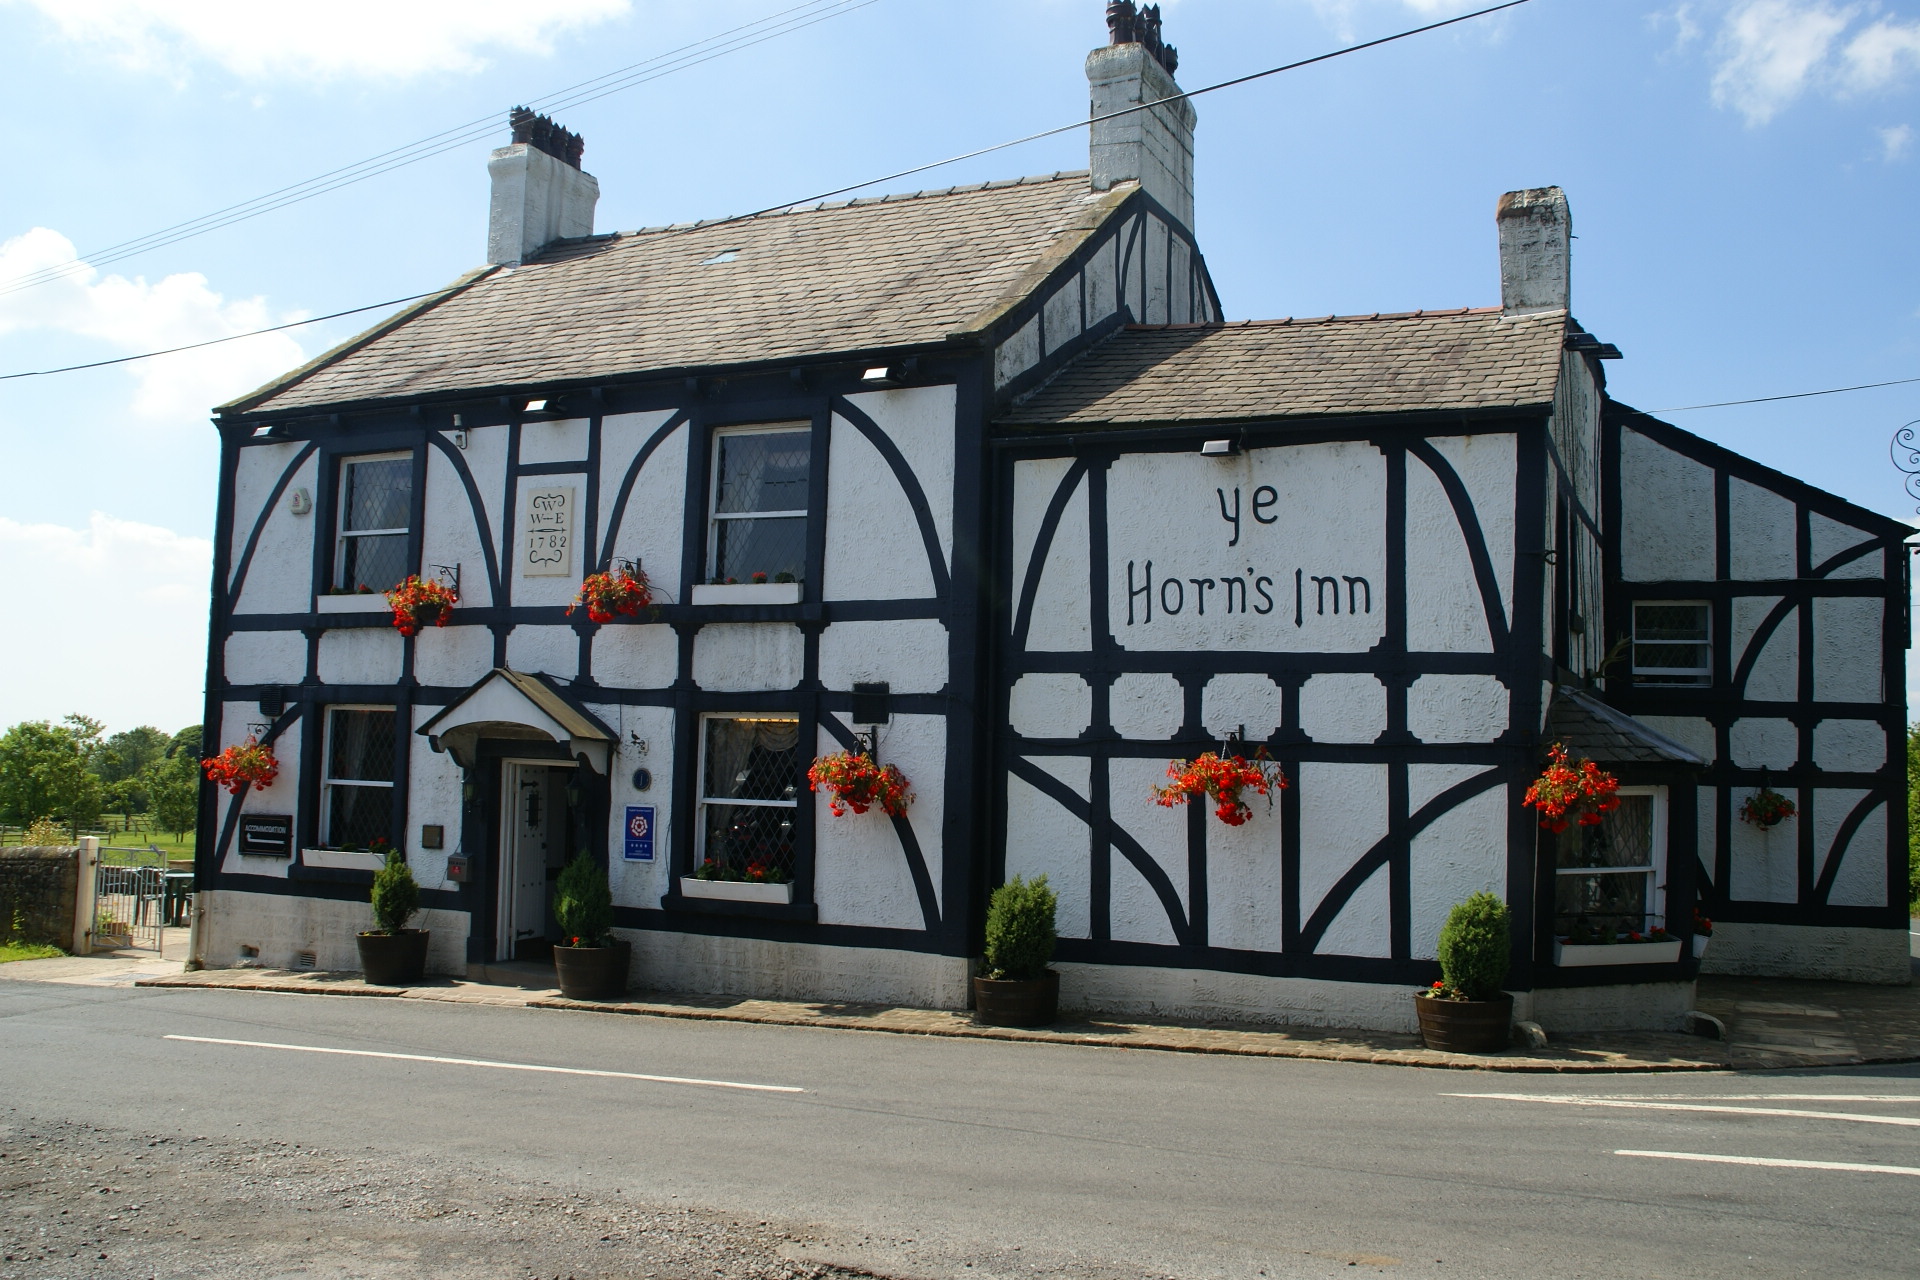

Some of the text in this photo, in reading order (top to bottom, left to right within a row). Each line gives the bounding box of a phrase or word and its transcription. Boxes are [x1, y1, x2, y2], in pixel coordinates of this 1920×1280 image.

[541, 500, 557, 511] W
[529, 534, 567, 548] 1782
[1126, 559, 1371, 629] Horn's Inn
[244, 824, 287, 834] ACCOMMODATION
